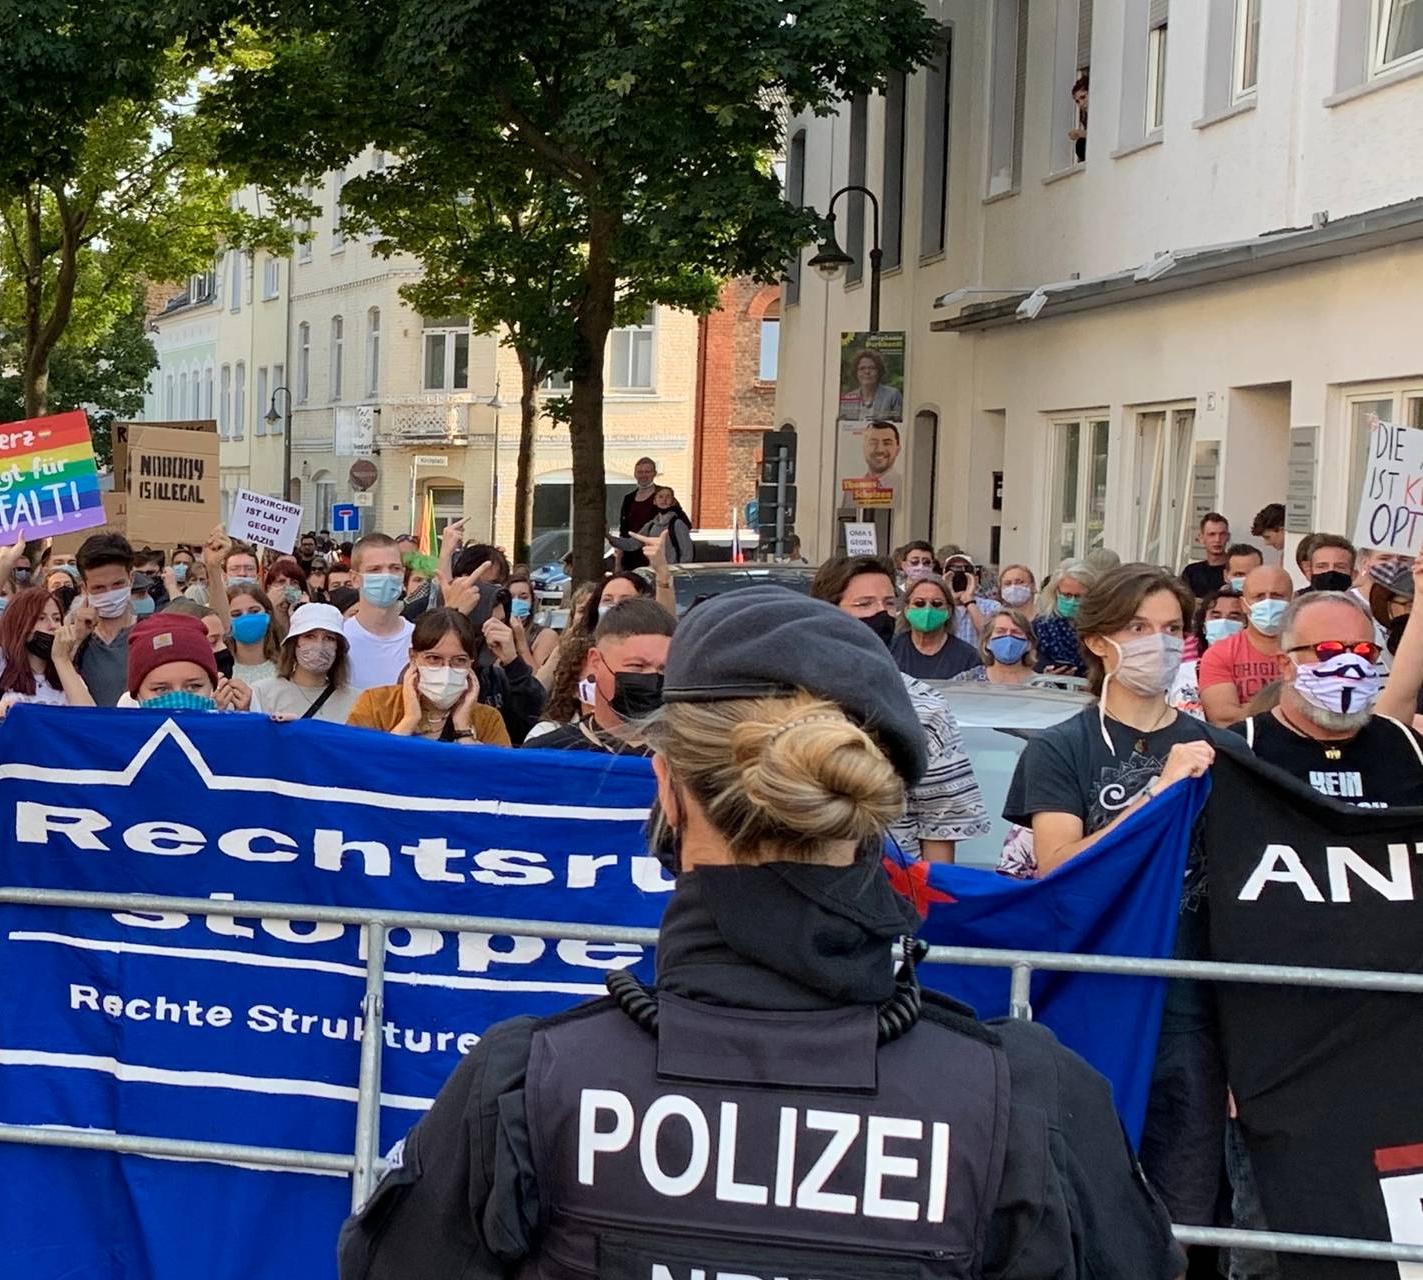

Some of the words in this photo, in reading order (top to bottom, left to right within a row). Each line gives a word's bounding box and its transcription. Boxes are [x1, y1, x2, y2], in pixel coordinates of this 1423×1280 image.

[1376, 423, 1406, 461] DIE
[32, 456, 69, 480] für
[139, 481, 152, 499] IS
[1369, 467, 1399, 500] IST
[242, 493, 300, 516] EUSKIRCHEN
[246, 507, 262, 519] IST
[263, 512, 288, 524] LAUT
[248, 520, 279, 535] GEGEN
[247, 533, 274, 547] NAZIS
[1238, 843, 1423, 903] AN
[69, 983, 233, 1029] Rechte
[578, 1087, 950, 1224] POLIZEI
